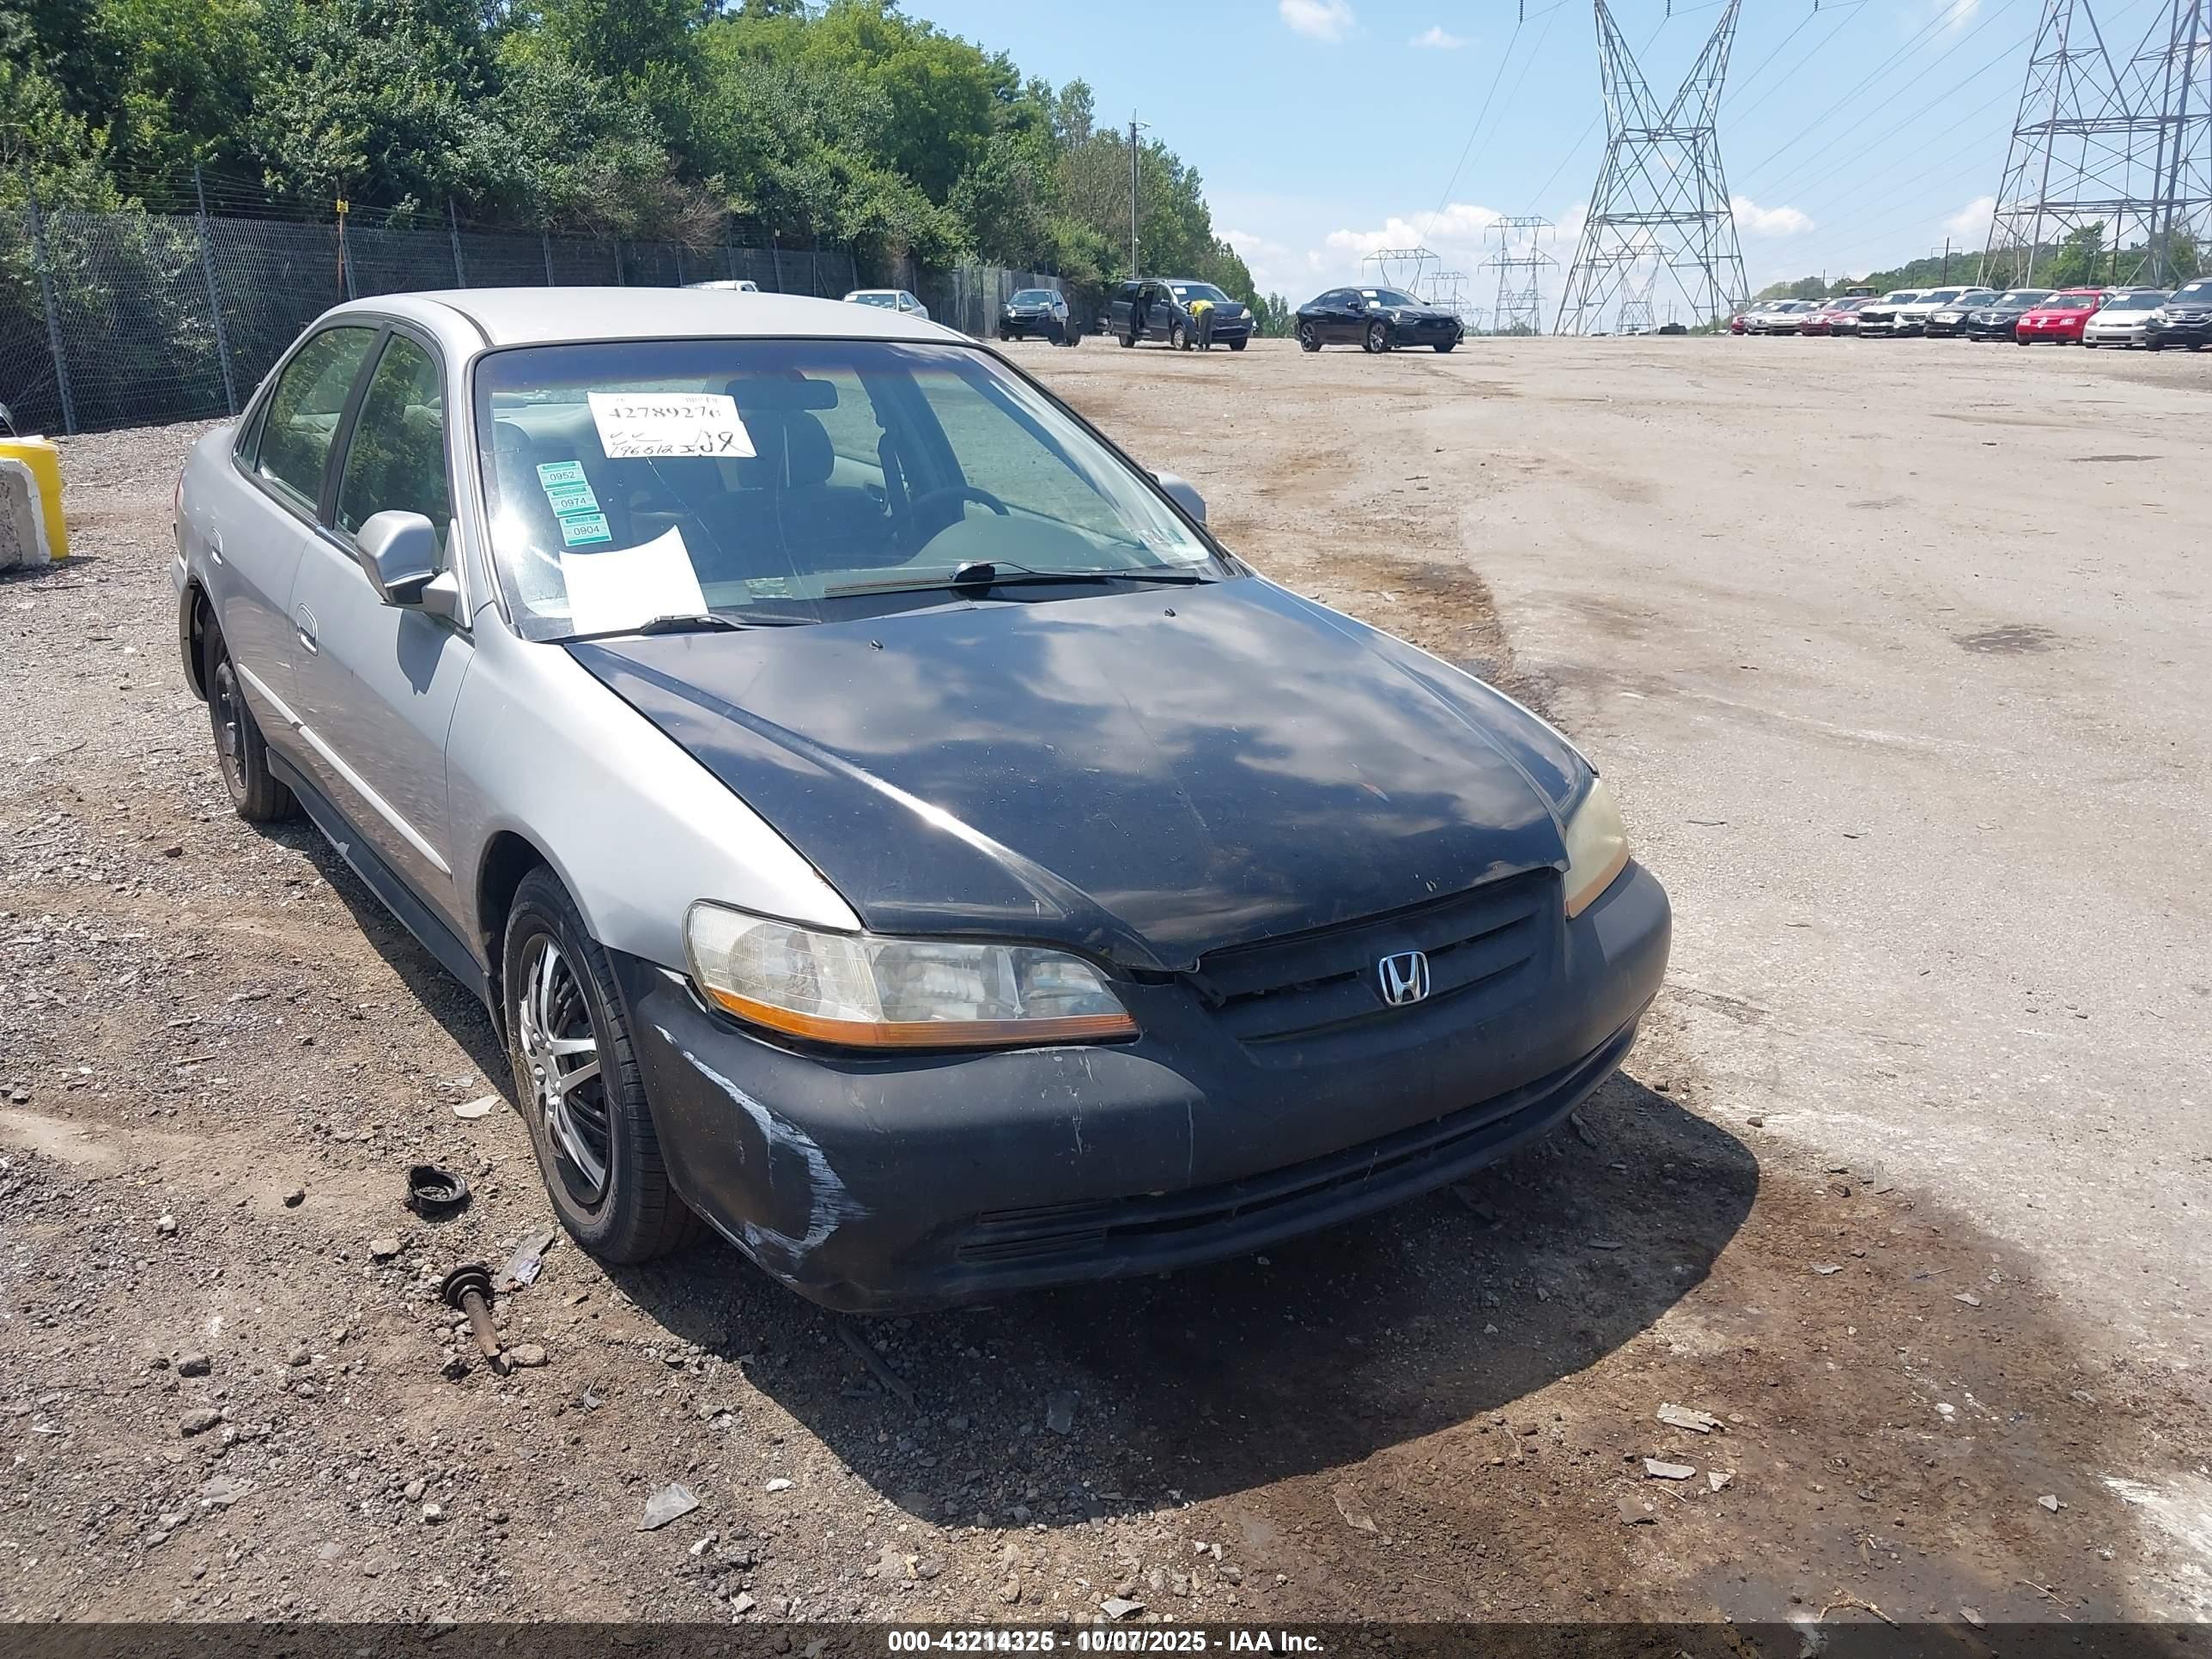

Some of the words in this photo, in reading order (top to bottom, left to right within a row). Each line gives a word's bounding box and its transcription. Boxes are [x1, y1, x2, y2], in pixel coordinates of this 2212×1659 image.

[550, 471, 576, 481] 0952
[560, 497, 586, 507] 0974
[573, 525, 600, 536] 0904
